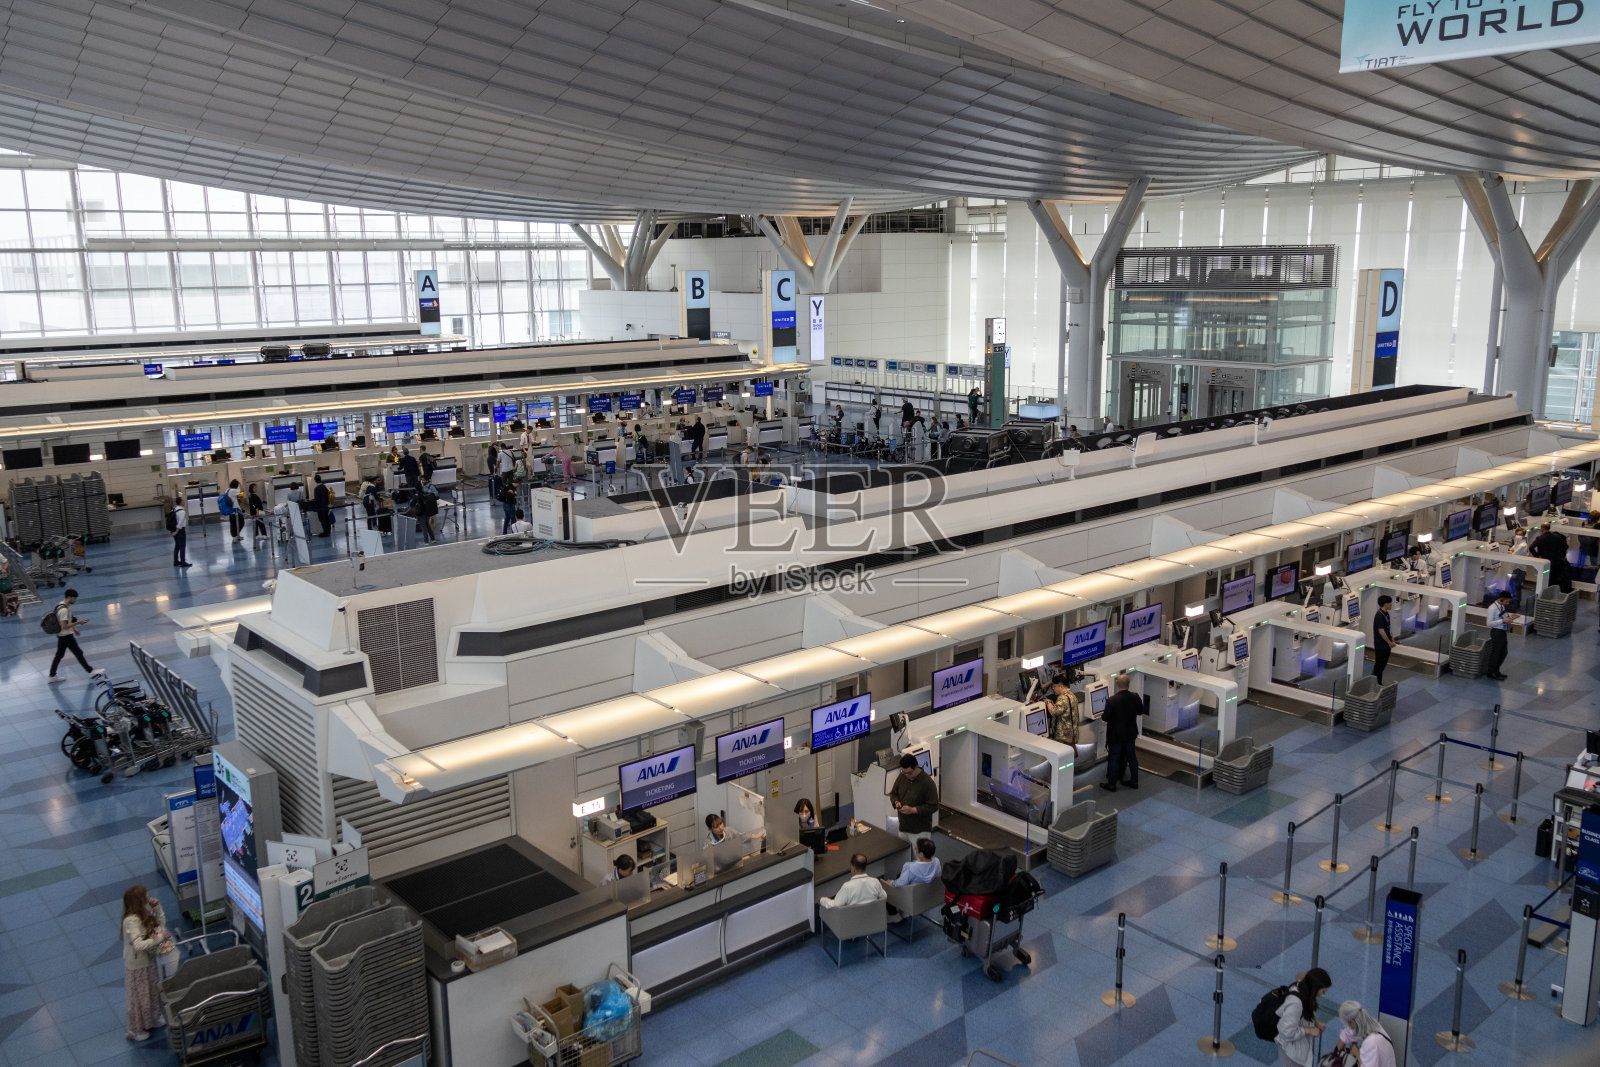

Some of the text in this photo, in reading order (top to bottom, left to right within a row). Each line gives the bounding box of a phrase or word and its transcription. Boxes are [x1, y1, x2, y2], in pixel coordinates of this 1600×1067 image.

[1398, 0, 1441, 19] FLY
[1397, 0, 1584, 47] WORLD
[421, 275, 436, 291] A
[691, 277, 705, 300] B
[776, 277, 791, 302] C
[812, 299, 823, 317] Y
[1381, 280, 1398, 318] D
[1129, 616, 1147, 631] ANA
[1072, 631, 1091, 645] ANA
[941, 673, 963, 691] ANA
[824, 707, 848, 725] ANA
[731, 734, 757, 753] ANA
[739, 753, 766, 767] TICKETING
[636, 762, 666, 783] ANA
[644, 782, 675, 797] TICKETING
[300, 884, 315, 908] 2
[1392, 921, 1404, 967] ASSISTANCE
[1402, 924, 1413, 953] SPECIAL
[189, 1022, 234, 1047] ANA
